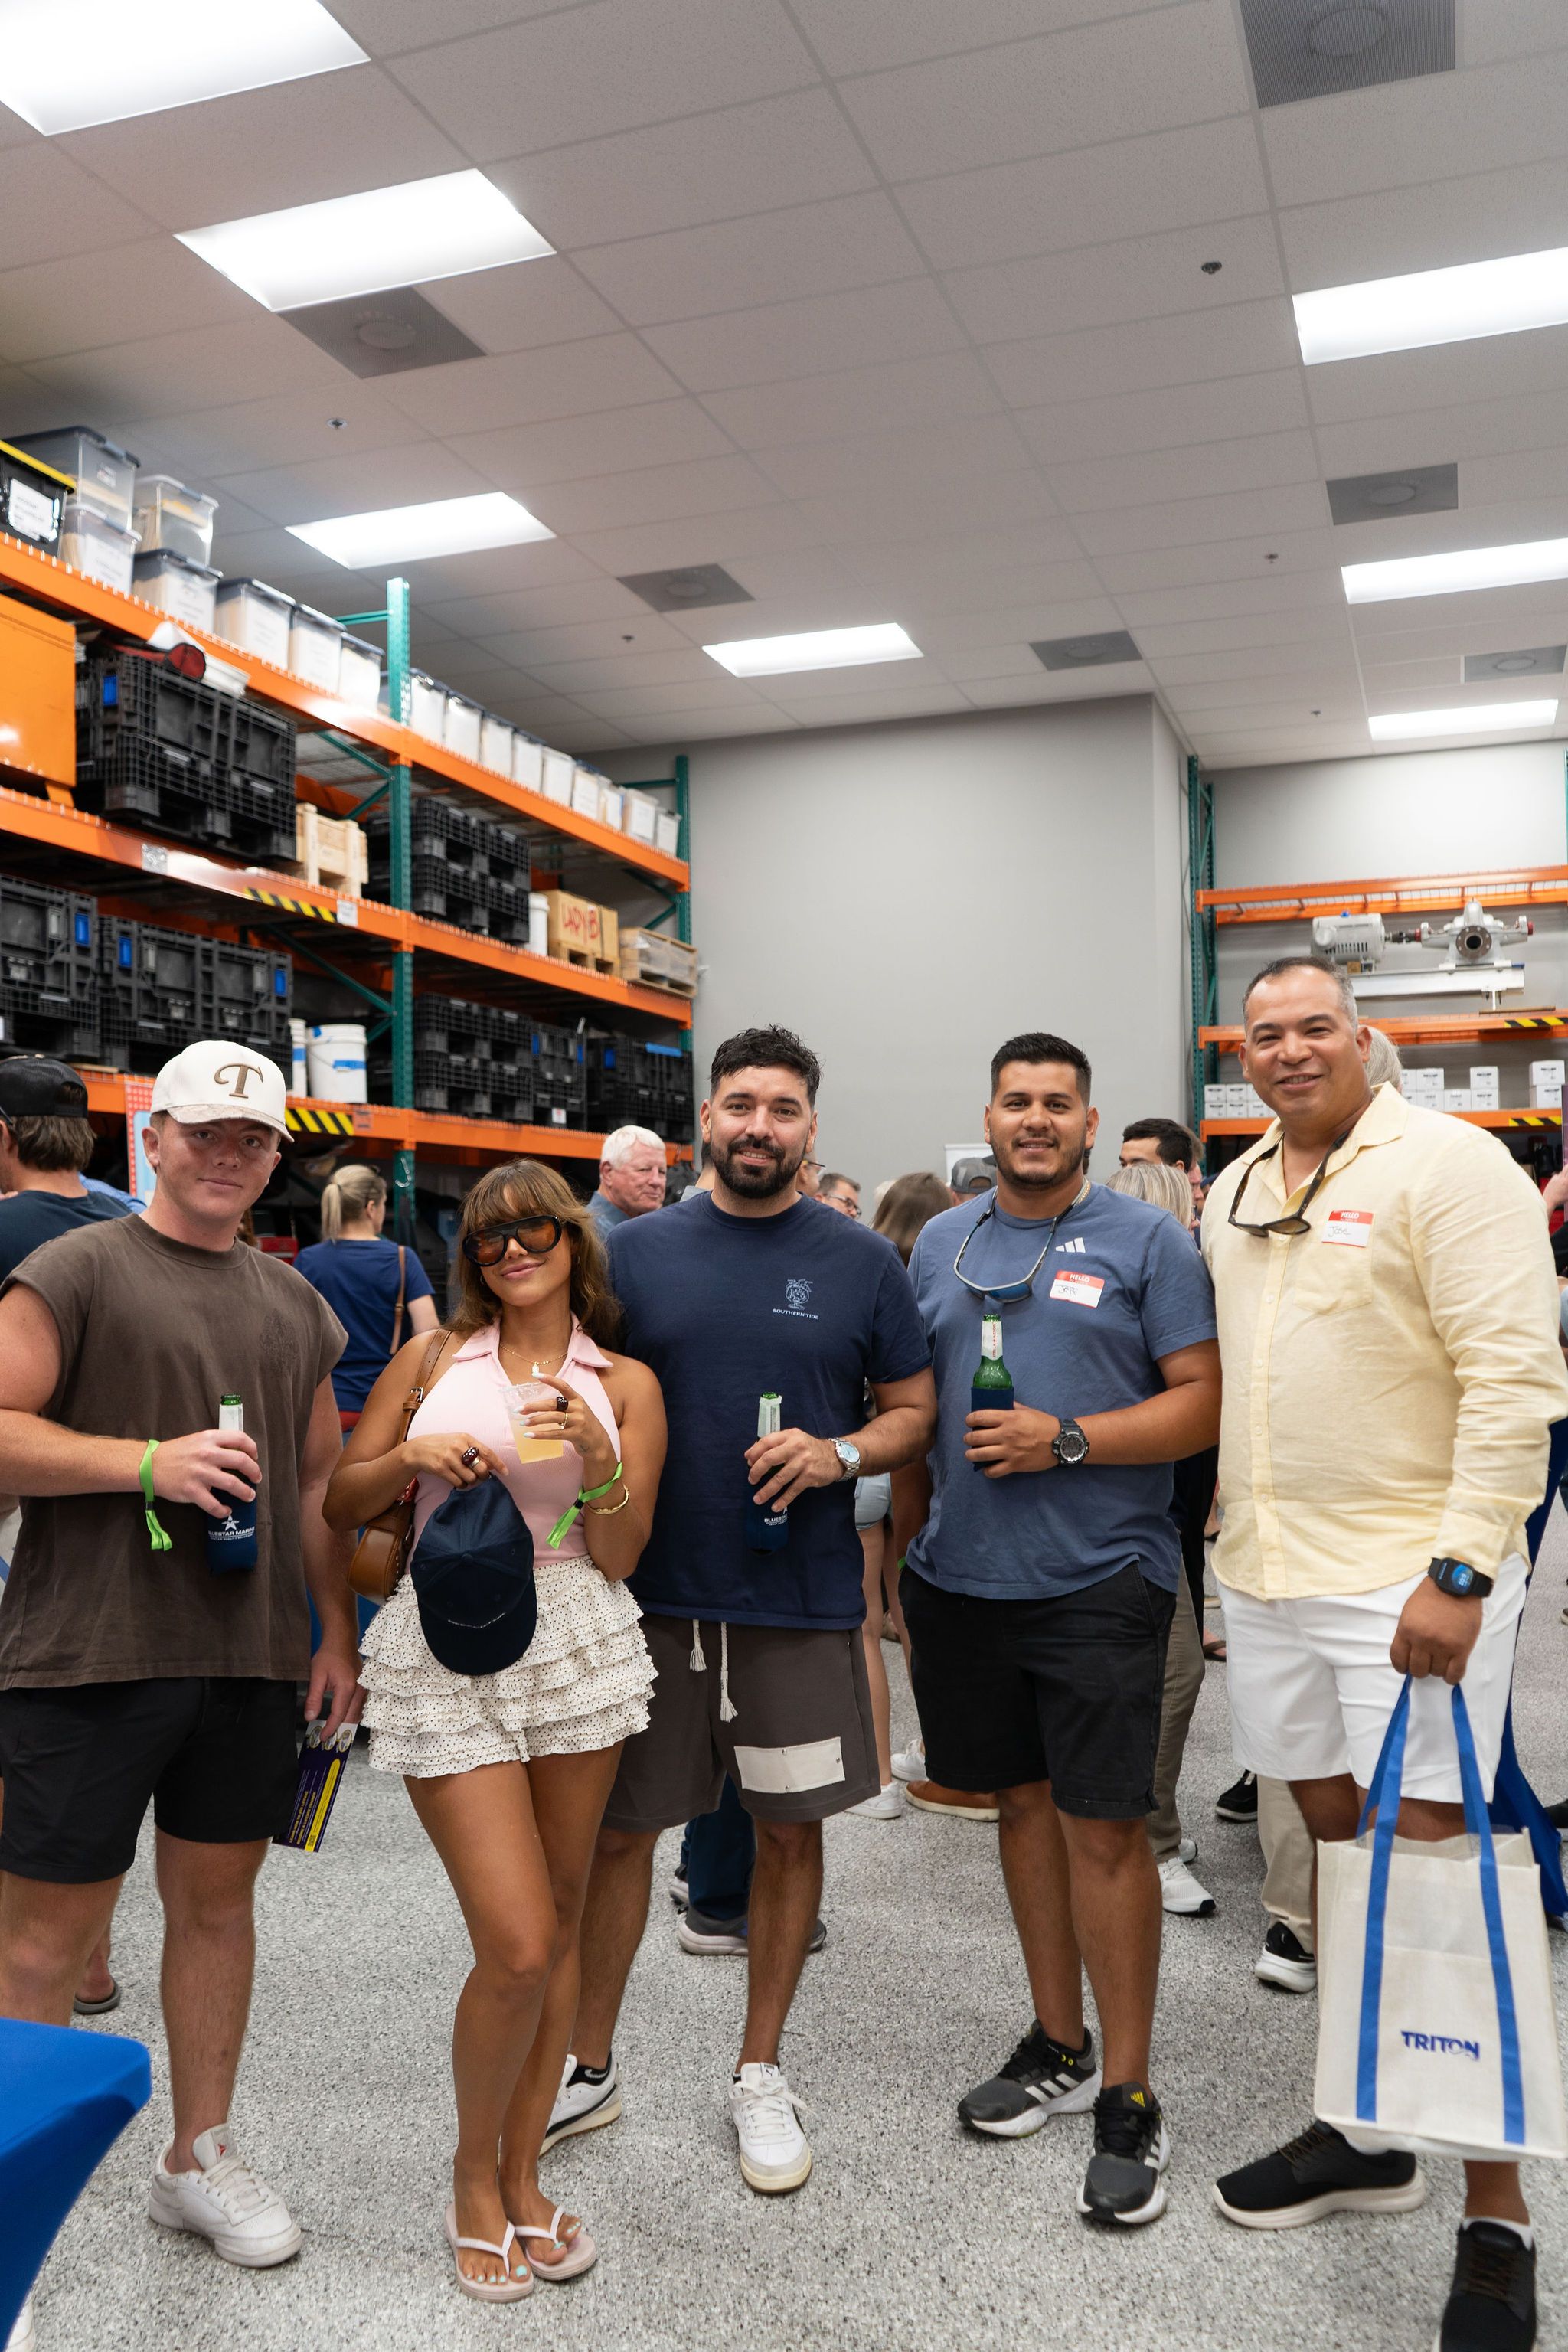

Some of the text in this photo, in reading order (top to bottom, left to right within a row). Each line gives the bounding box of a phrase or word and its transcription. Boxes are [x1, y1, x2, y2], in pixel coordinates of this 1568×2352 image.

[214, 1063, 264, 1099] T
[1070, 1273, 1090, 1282] HELLO
[773, 1308, 805, 1317] SOUTHERN
[1400, 2030, 1479, 2060] TRITON
